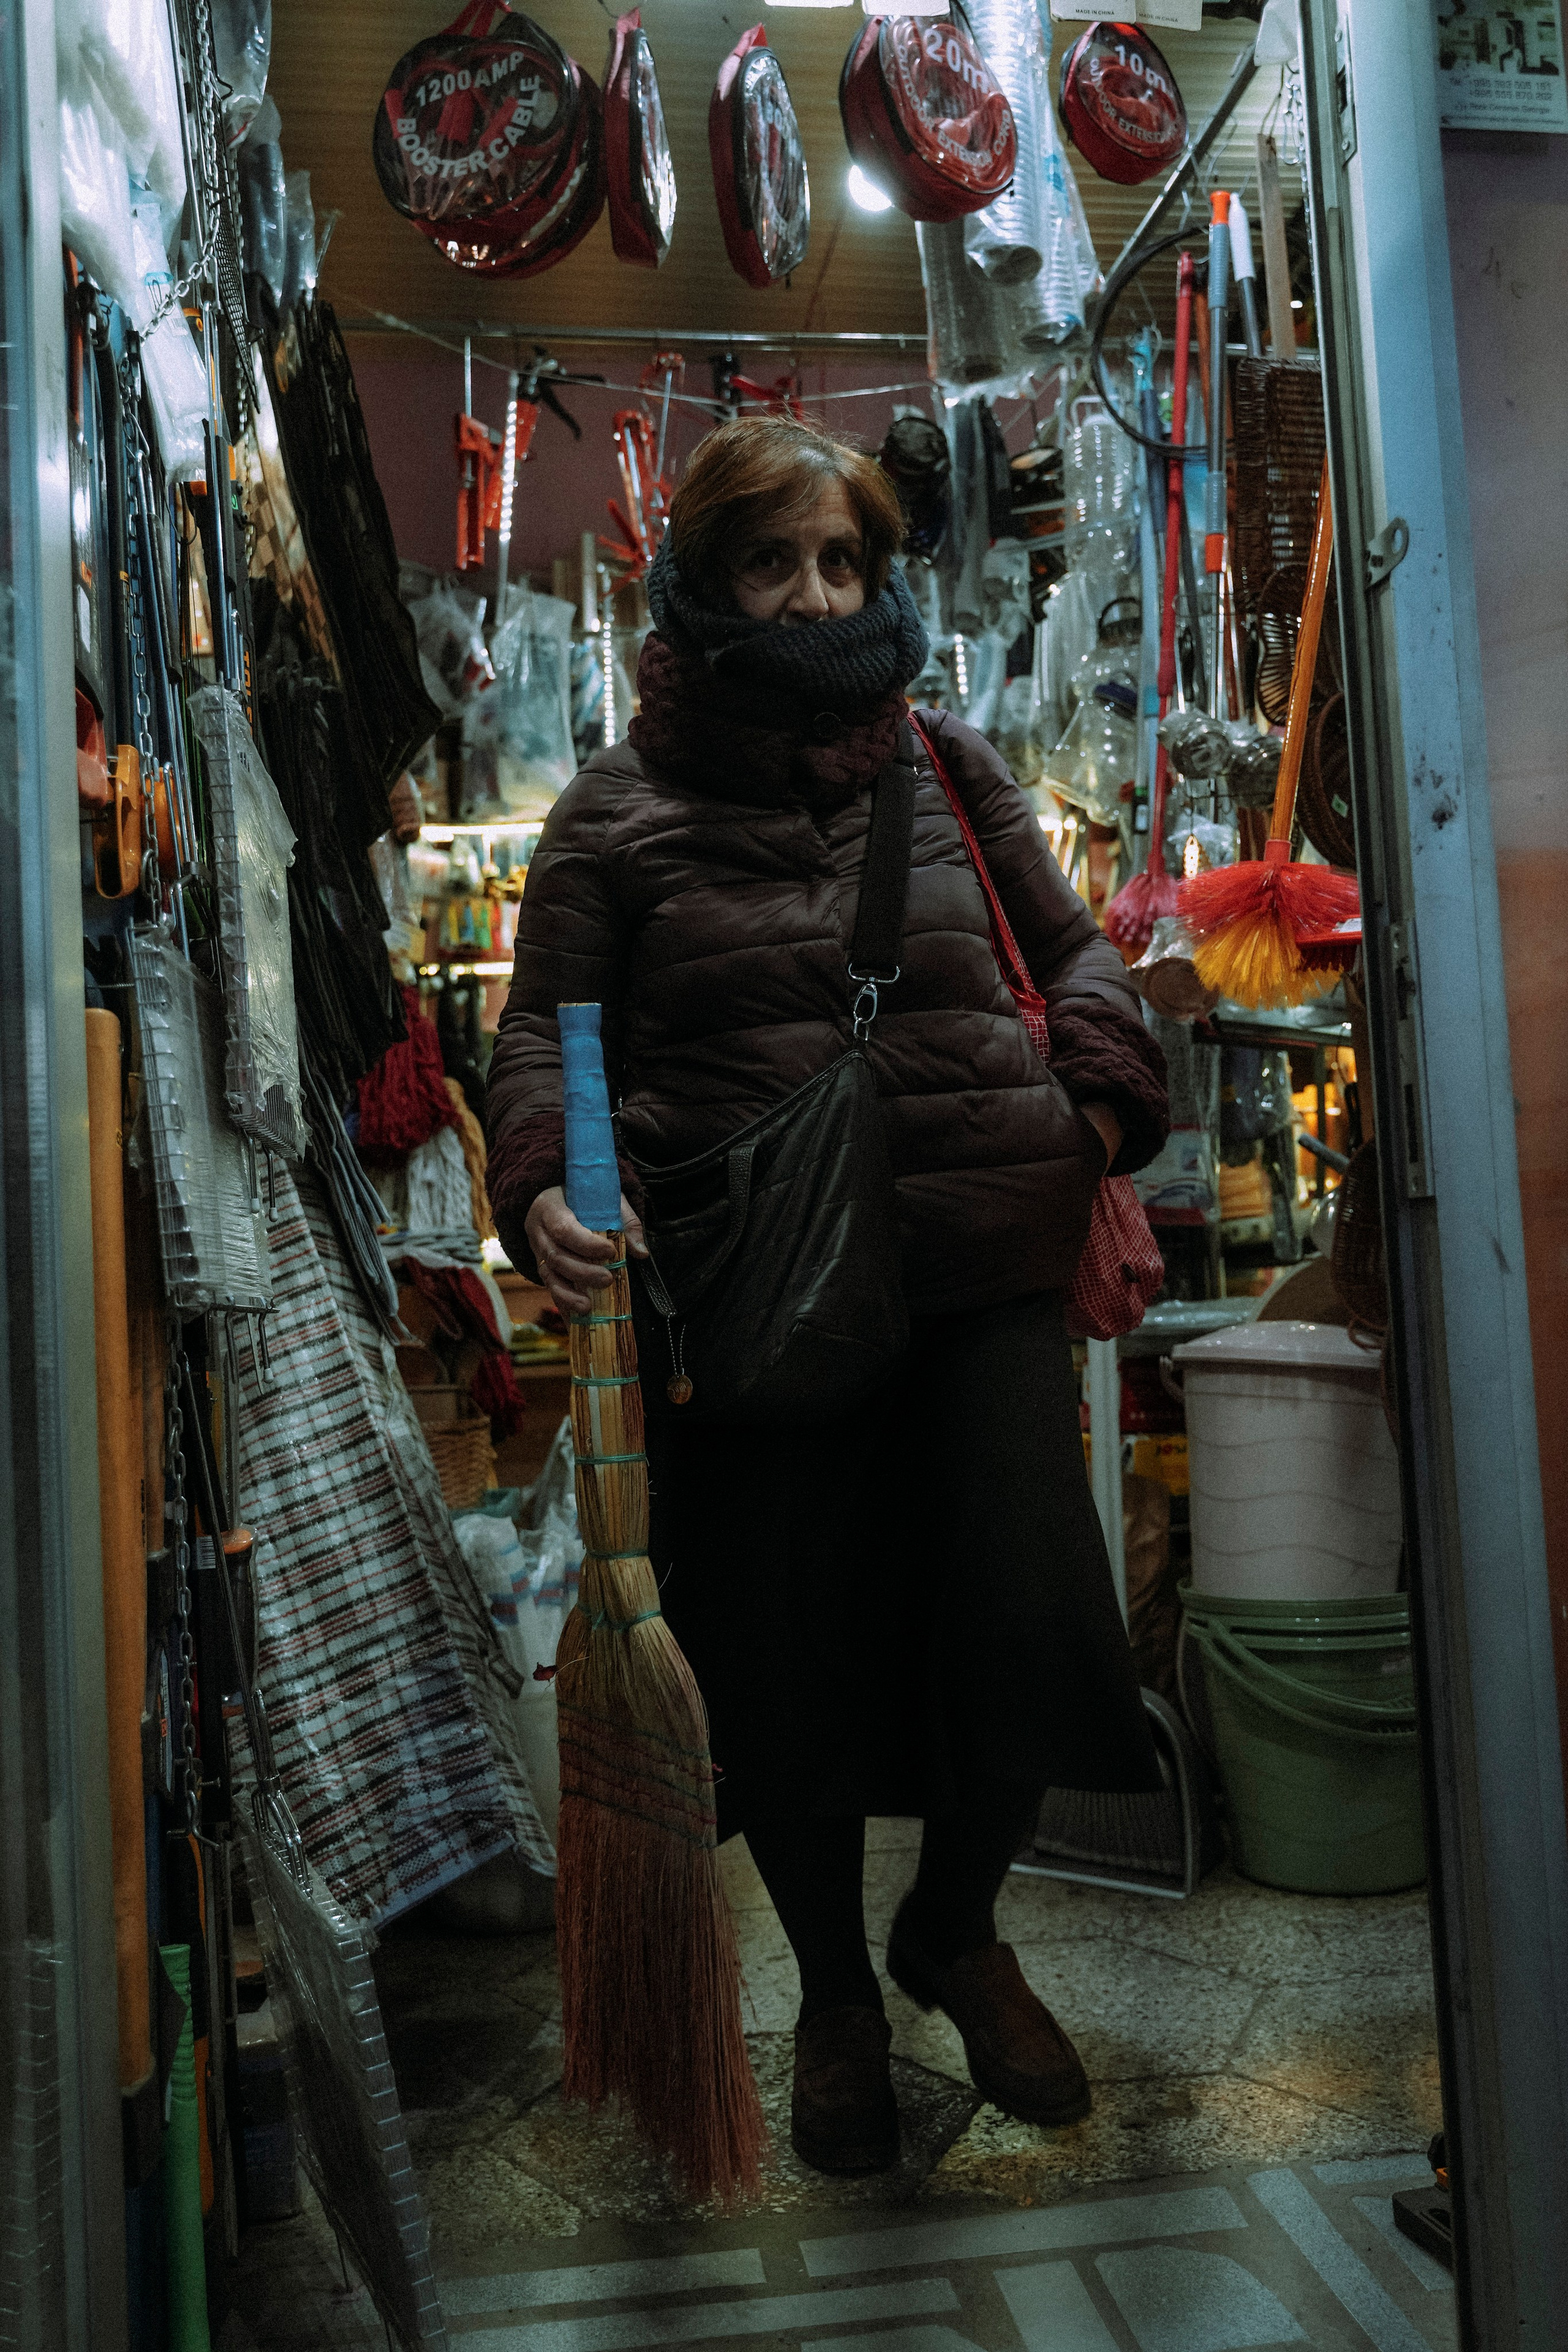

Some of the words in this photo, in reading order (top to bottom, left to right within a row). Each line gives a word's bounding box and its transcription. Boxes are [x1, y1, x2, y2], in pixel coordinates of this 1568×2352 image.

[924, 28, 989, 93] 20m
[1114, 44, 1167, 93] 10m
[396, 117, 489, 178] BOOSTER
[490, 75, 541, 160] CABLE
